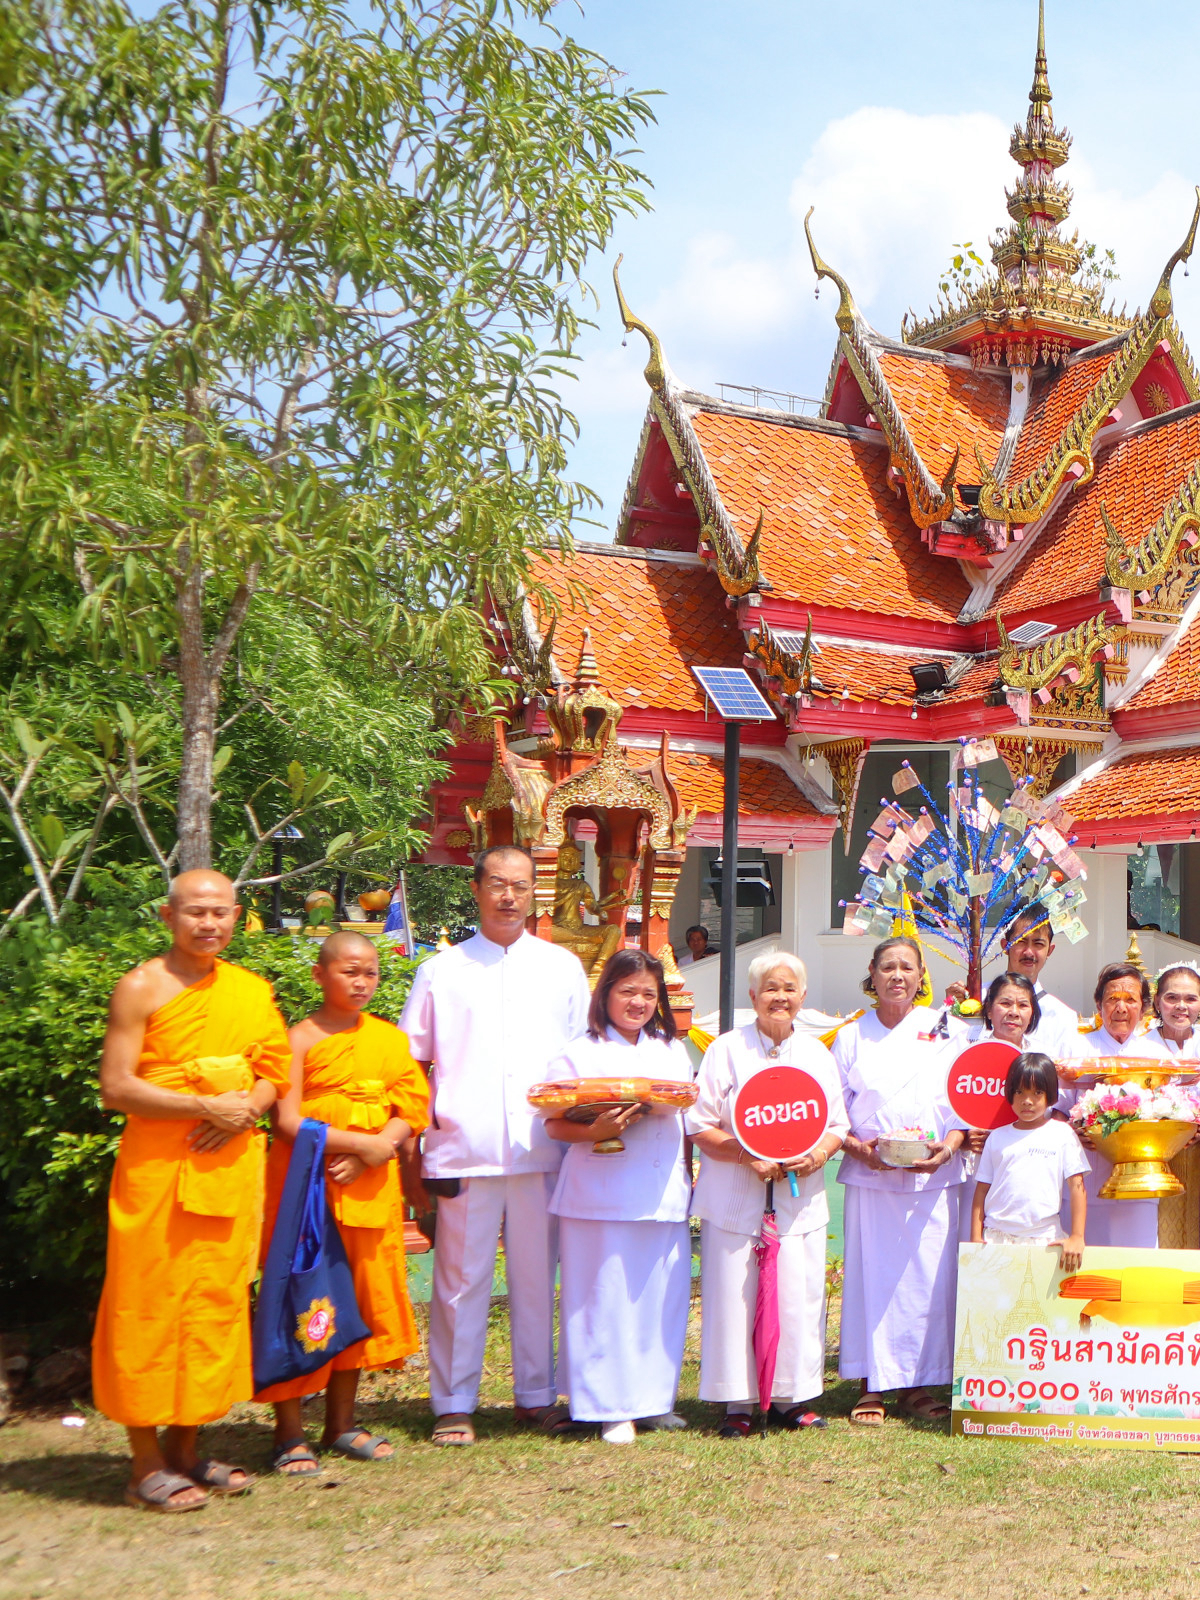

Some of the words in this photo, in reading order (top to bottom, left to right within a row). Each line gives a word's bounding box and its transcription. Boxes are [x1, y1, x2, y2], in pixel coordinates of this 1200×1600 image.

[744, 1099, 820, 1127] สงขลา
[965, 1378, 1080, 1403] ๓๐,๐๐๐
[1088, 1380, 1113, 1402] วัด
[963, 1418, 984, 1434] โดย
[987, 1421, 1074, 1441] คณะศิษยานุศิษย์
[1077, 1426, 1150, 1440] จังหวัดสงขลา
